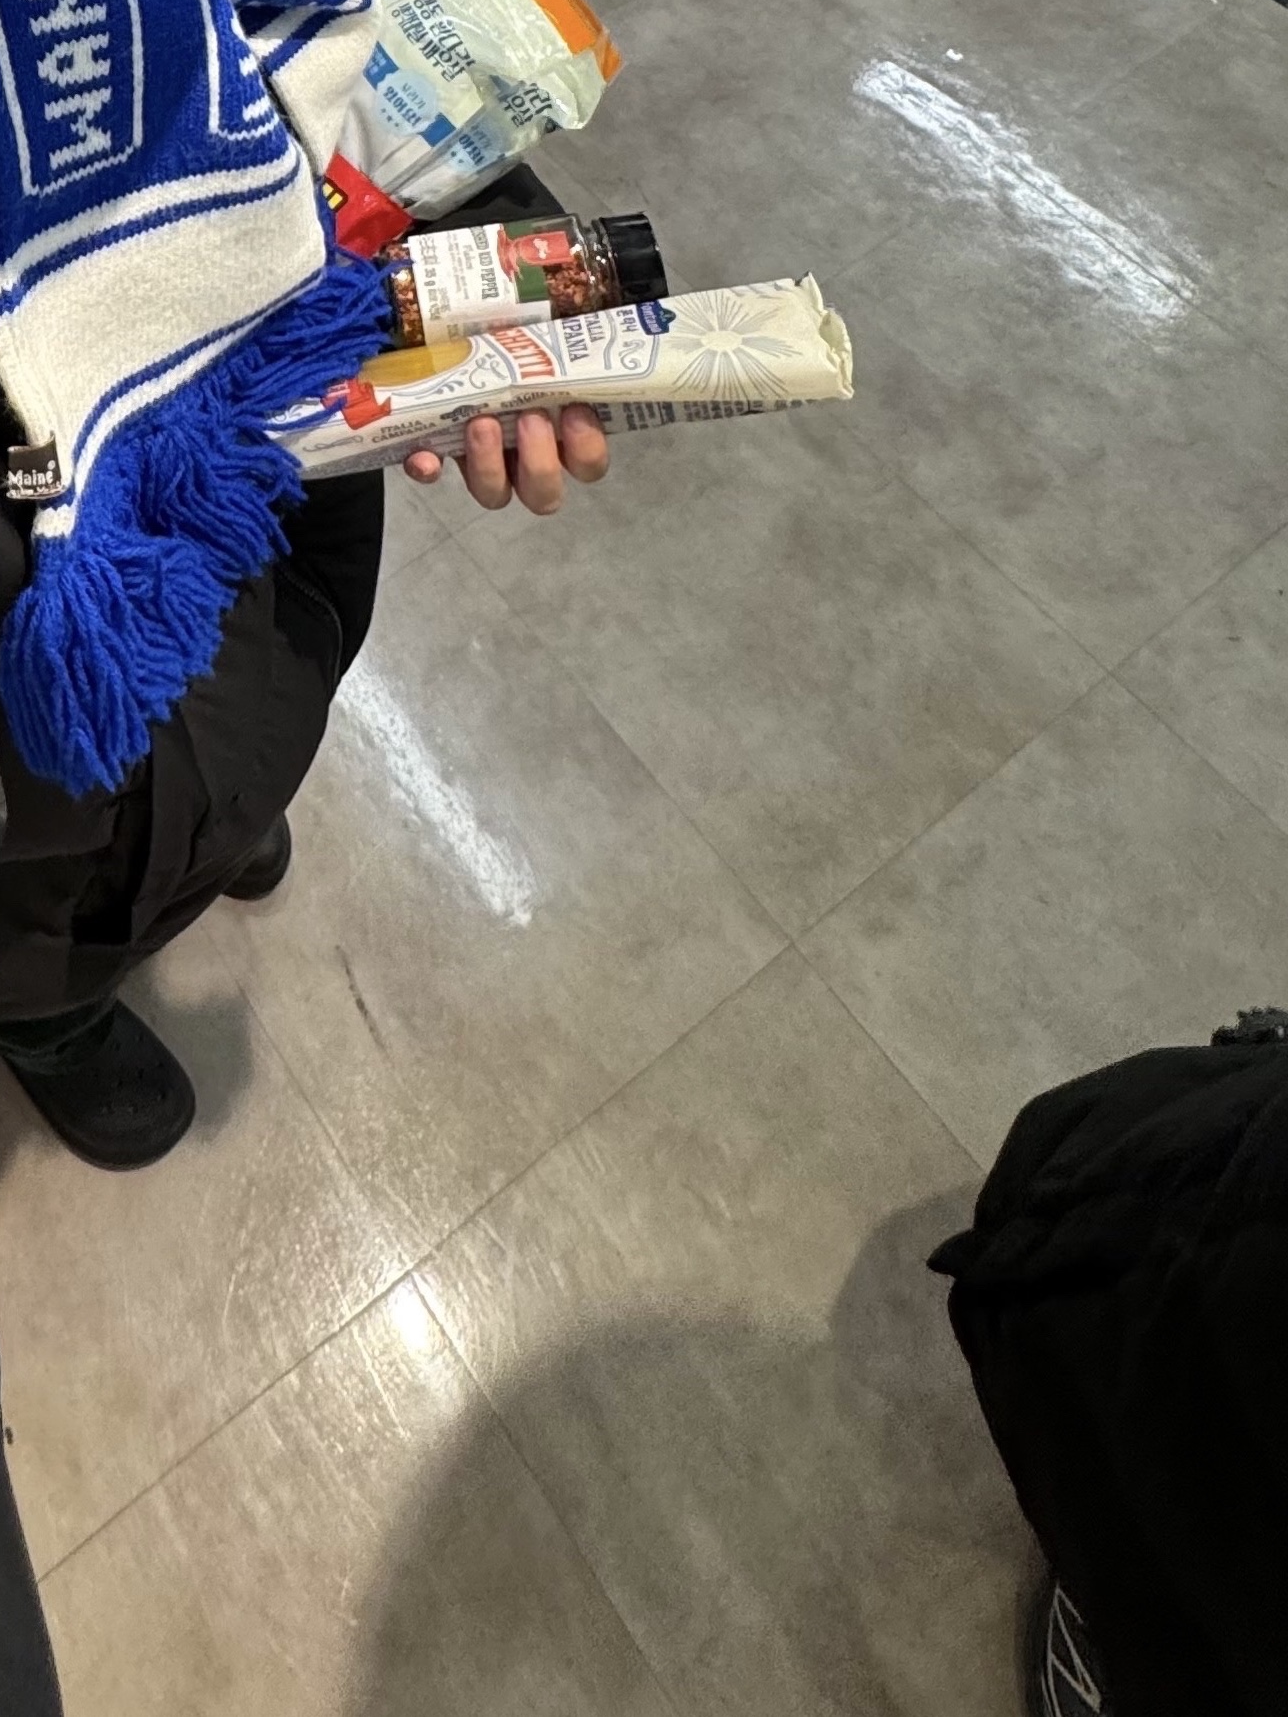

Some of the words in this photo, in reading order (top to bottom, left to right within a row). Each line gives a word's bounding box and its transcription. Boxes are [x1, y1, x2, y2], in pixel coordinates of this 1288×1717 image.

[418, 40, 466, 82] 새우살
[481, 267, 500, 300] PEPPER
[584, 312, 605, 342] TALIA
[643, 302, 662, 333] fontana
[494, 327, 557, 380] GHETTI
[562, 318, 589, 363] MPANIA
[371, 420, 438, 444] CAMPANIA
[381, 420, 423, 434] ITALIA
[8, 469, 54, 486] Maine
